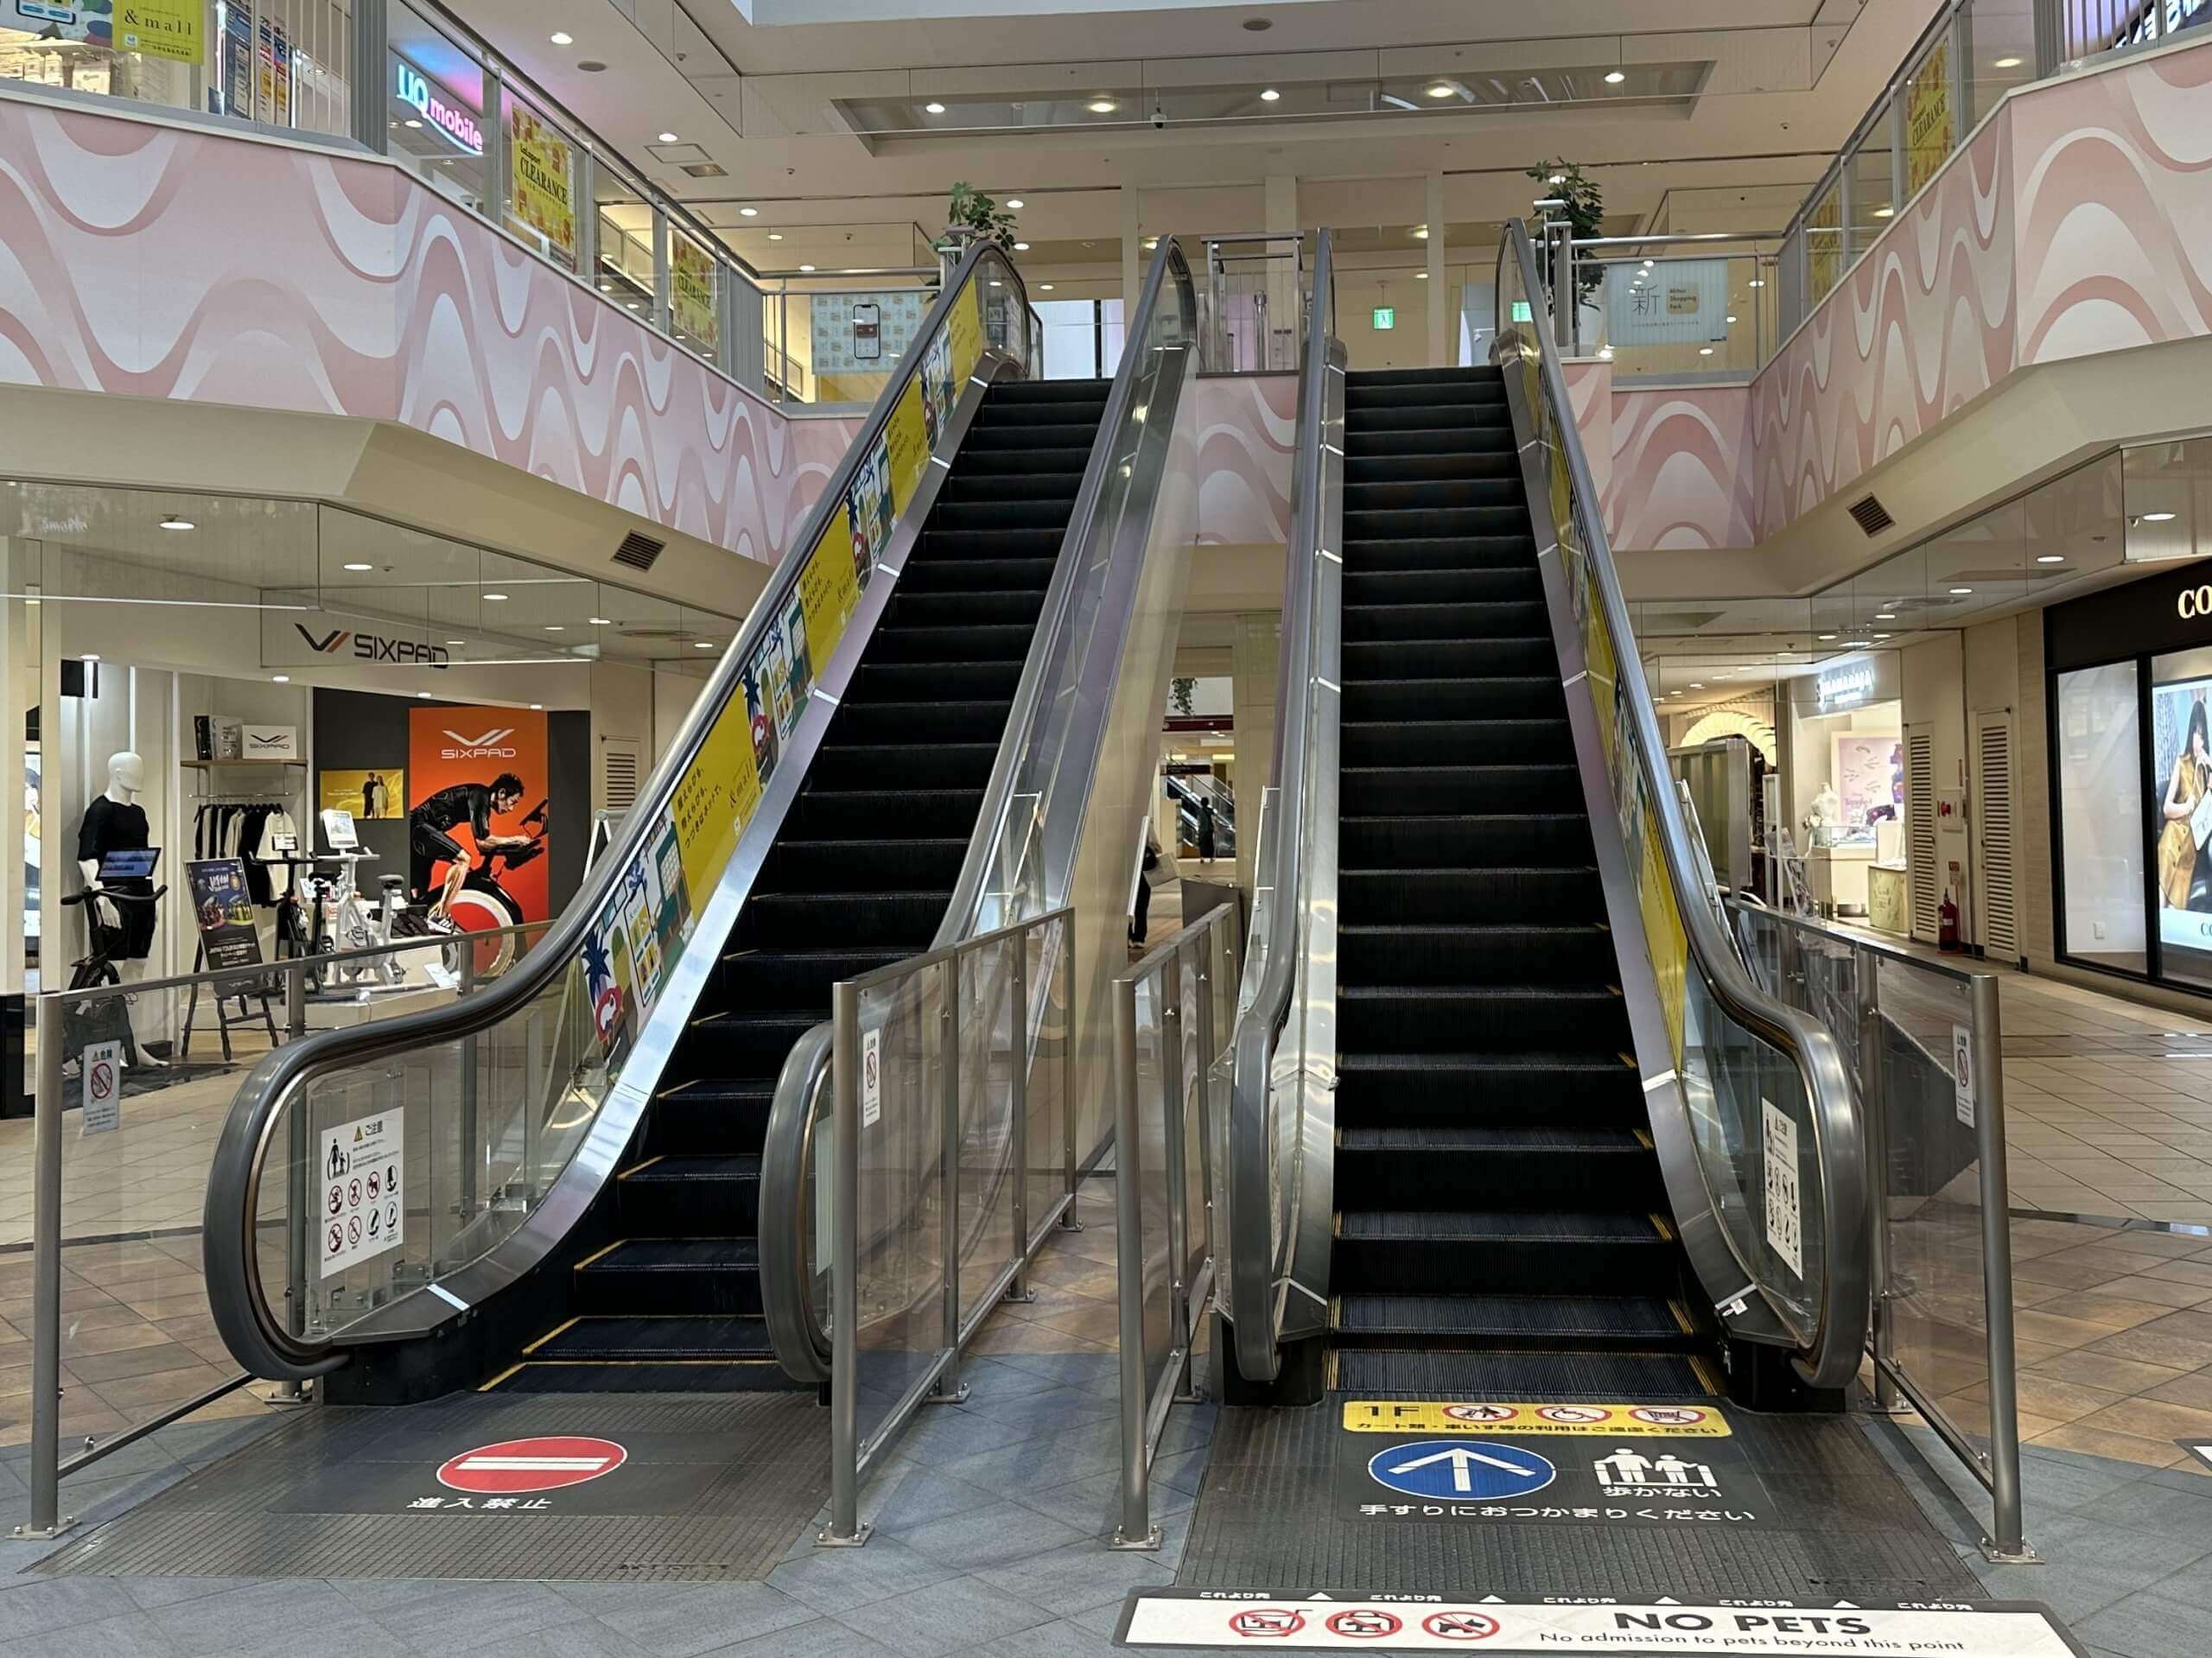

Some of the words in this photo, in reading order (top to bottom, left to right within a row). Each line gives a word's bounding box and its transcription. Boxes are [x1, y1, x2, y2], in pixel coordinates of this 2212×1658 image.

[124, 8, 139, 26] &
[144, 18, 191, 35] mall
[397, 64, 429, 118] UQ
[430, 98, 483, 151] mobile
[520, 156, 568, 205] CLEARANCE
[1630, 283, 1660, 315] 新
[2177, 585, 2212, 619] CO
[354, 633, 448, 670] SIXPAD
[441, 747, 517, 759] SIXPAD
[1363, 1406, 1420, 1417] 1F
[406, 1496, 552, 1509] 進入禁止
[1603, 1486, 1722, 1497] 歩かない
[1359, 1504, 1756, 1521] 手すりにおつかまりください
[1614, 1612, 1713, 1631] NO
[1732, 1614, 1872, 1636] PETS
[1541, 1632, 1573, 1642] No
[1581, 1632, 1688, 1644] admission
[1695, 1636, 1715, 1644] to
[1725, 1636, 1768, 1648] pets
[1773, 1636, 1856, 1649] beyond
[1864, 1639, 1901, 1649] this
[1909, 1640, 1965, 1652] point
